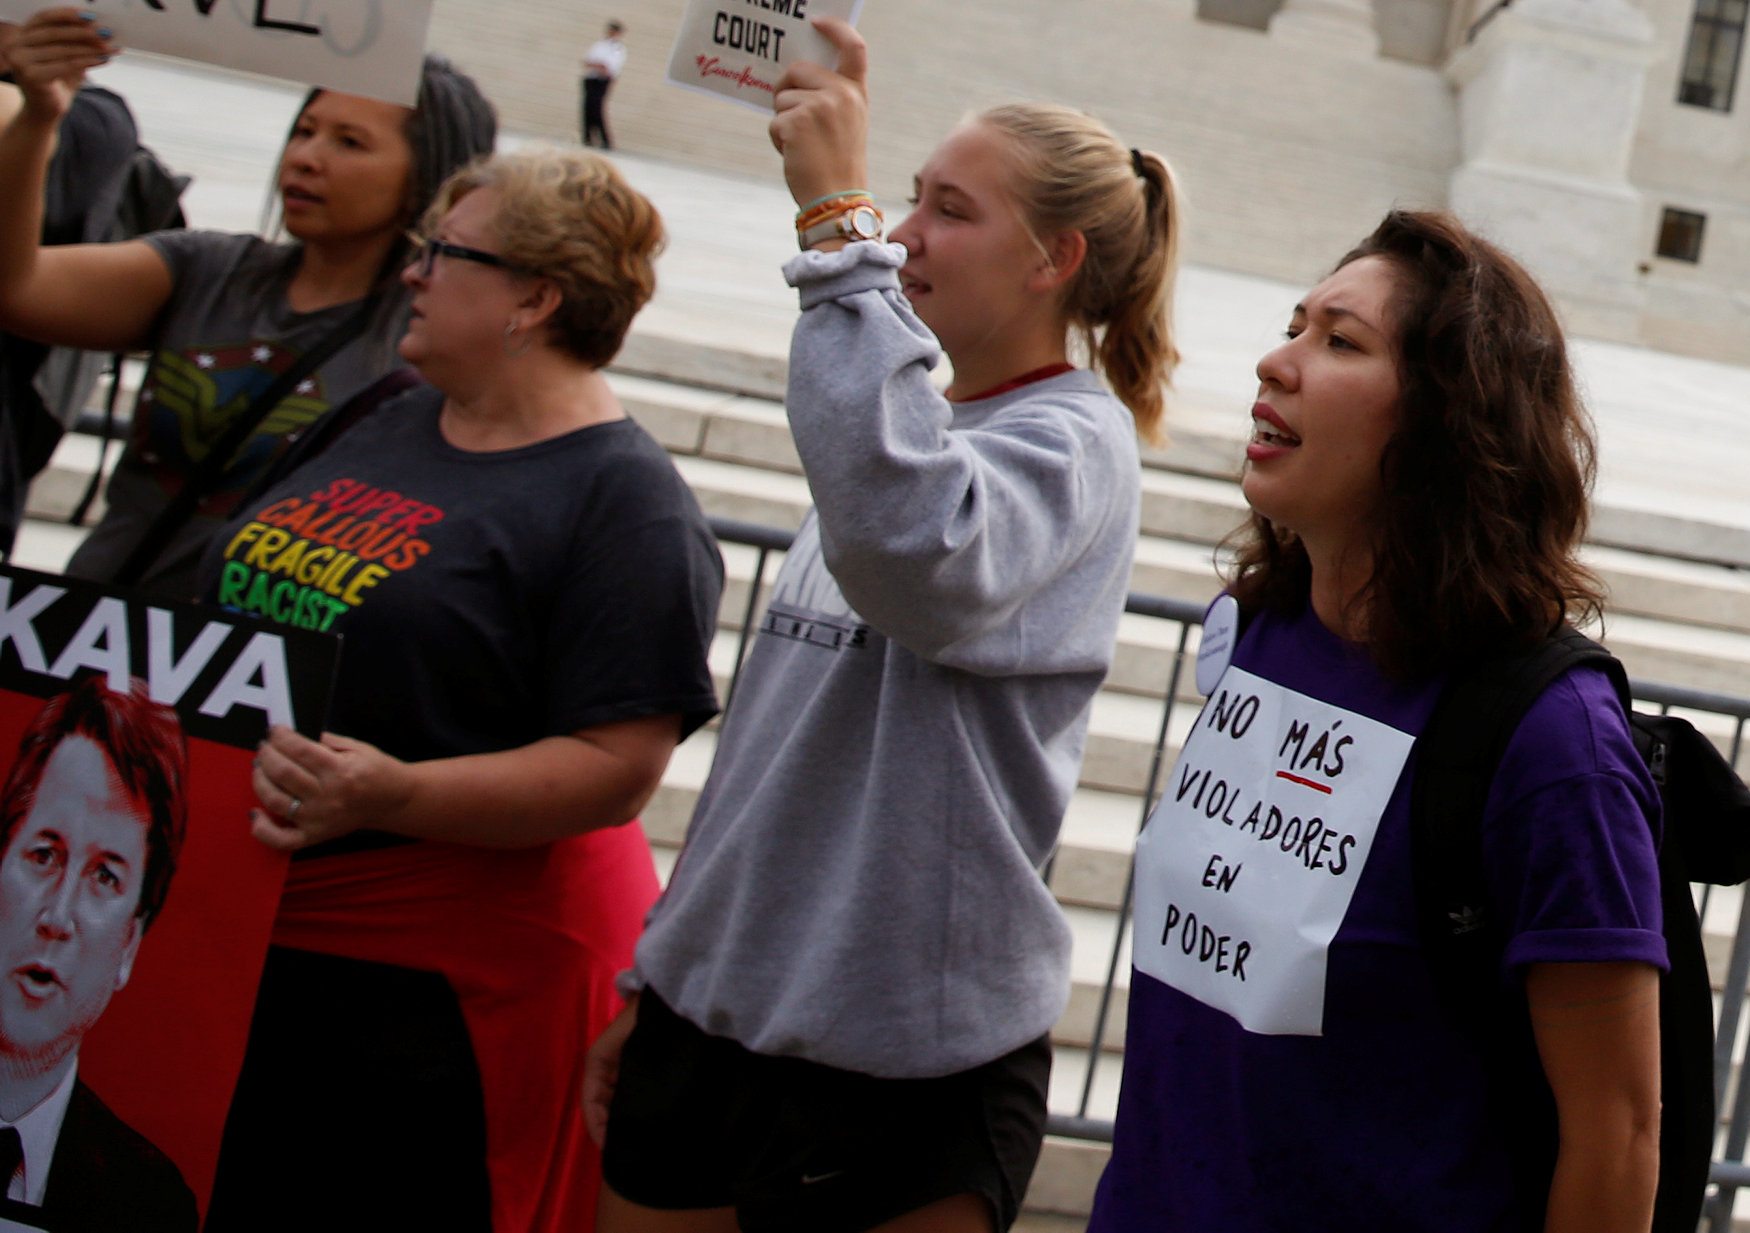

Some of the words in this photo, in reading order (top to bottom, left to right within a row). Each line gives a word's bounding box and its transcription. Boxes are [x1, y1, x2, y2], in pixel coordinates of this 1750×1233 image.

[713, 11, 786, 63] COURT
[256, 497, 432, 571] CALLOUS
[312, 478, 444, 536] SUPER
[218, 561, 349, 632] RACIST
[223, 522, 391, 606] FRAGILE
[0, 574, 296, 731] KAVA
[1207, 689, 1260, 740] NO
[1278, 720, 1354, 779] MÁS
[1175, 763, 1356, 876] VIOLADORES
[1202, 854, 1243, 894] EN
[1161, 903, 1251, 982] PODER
